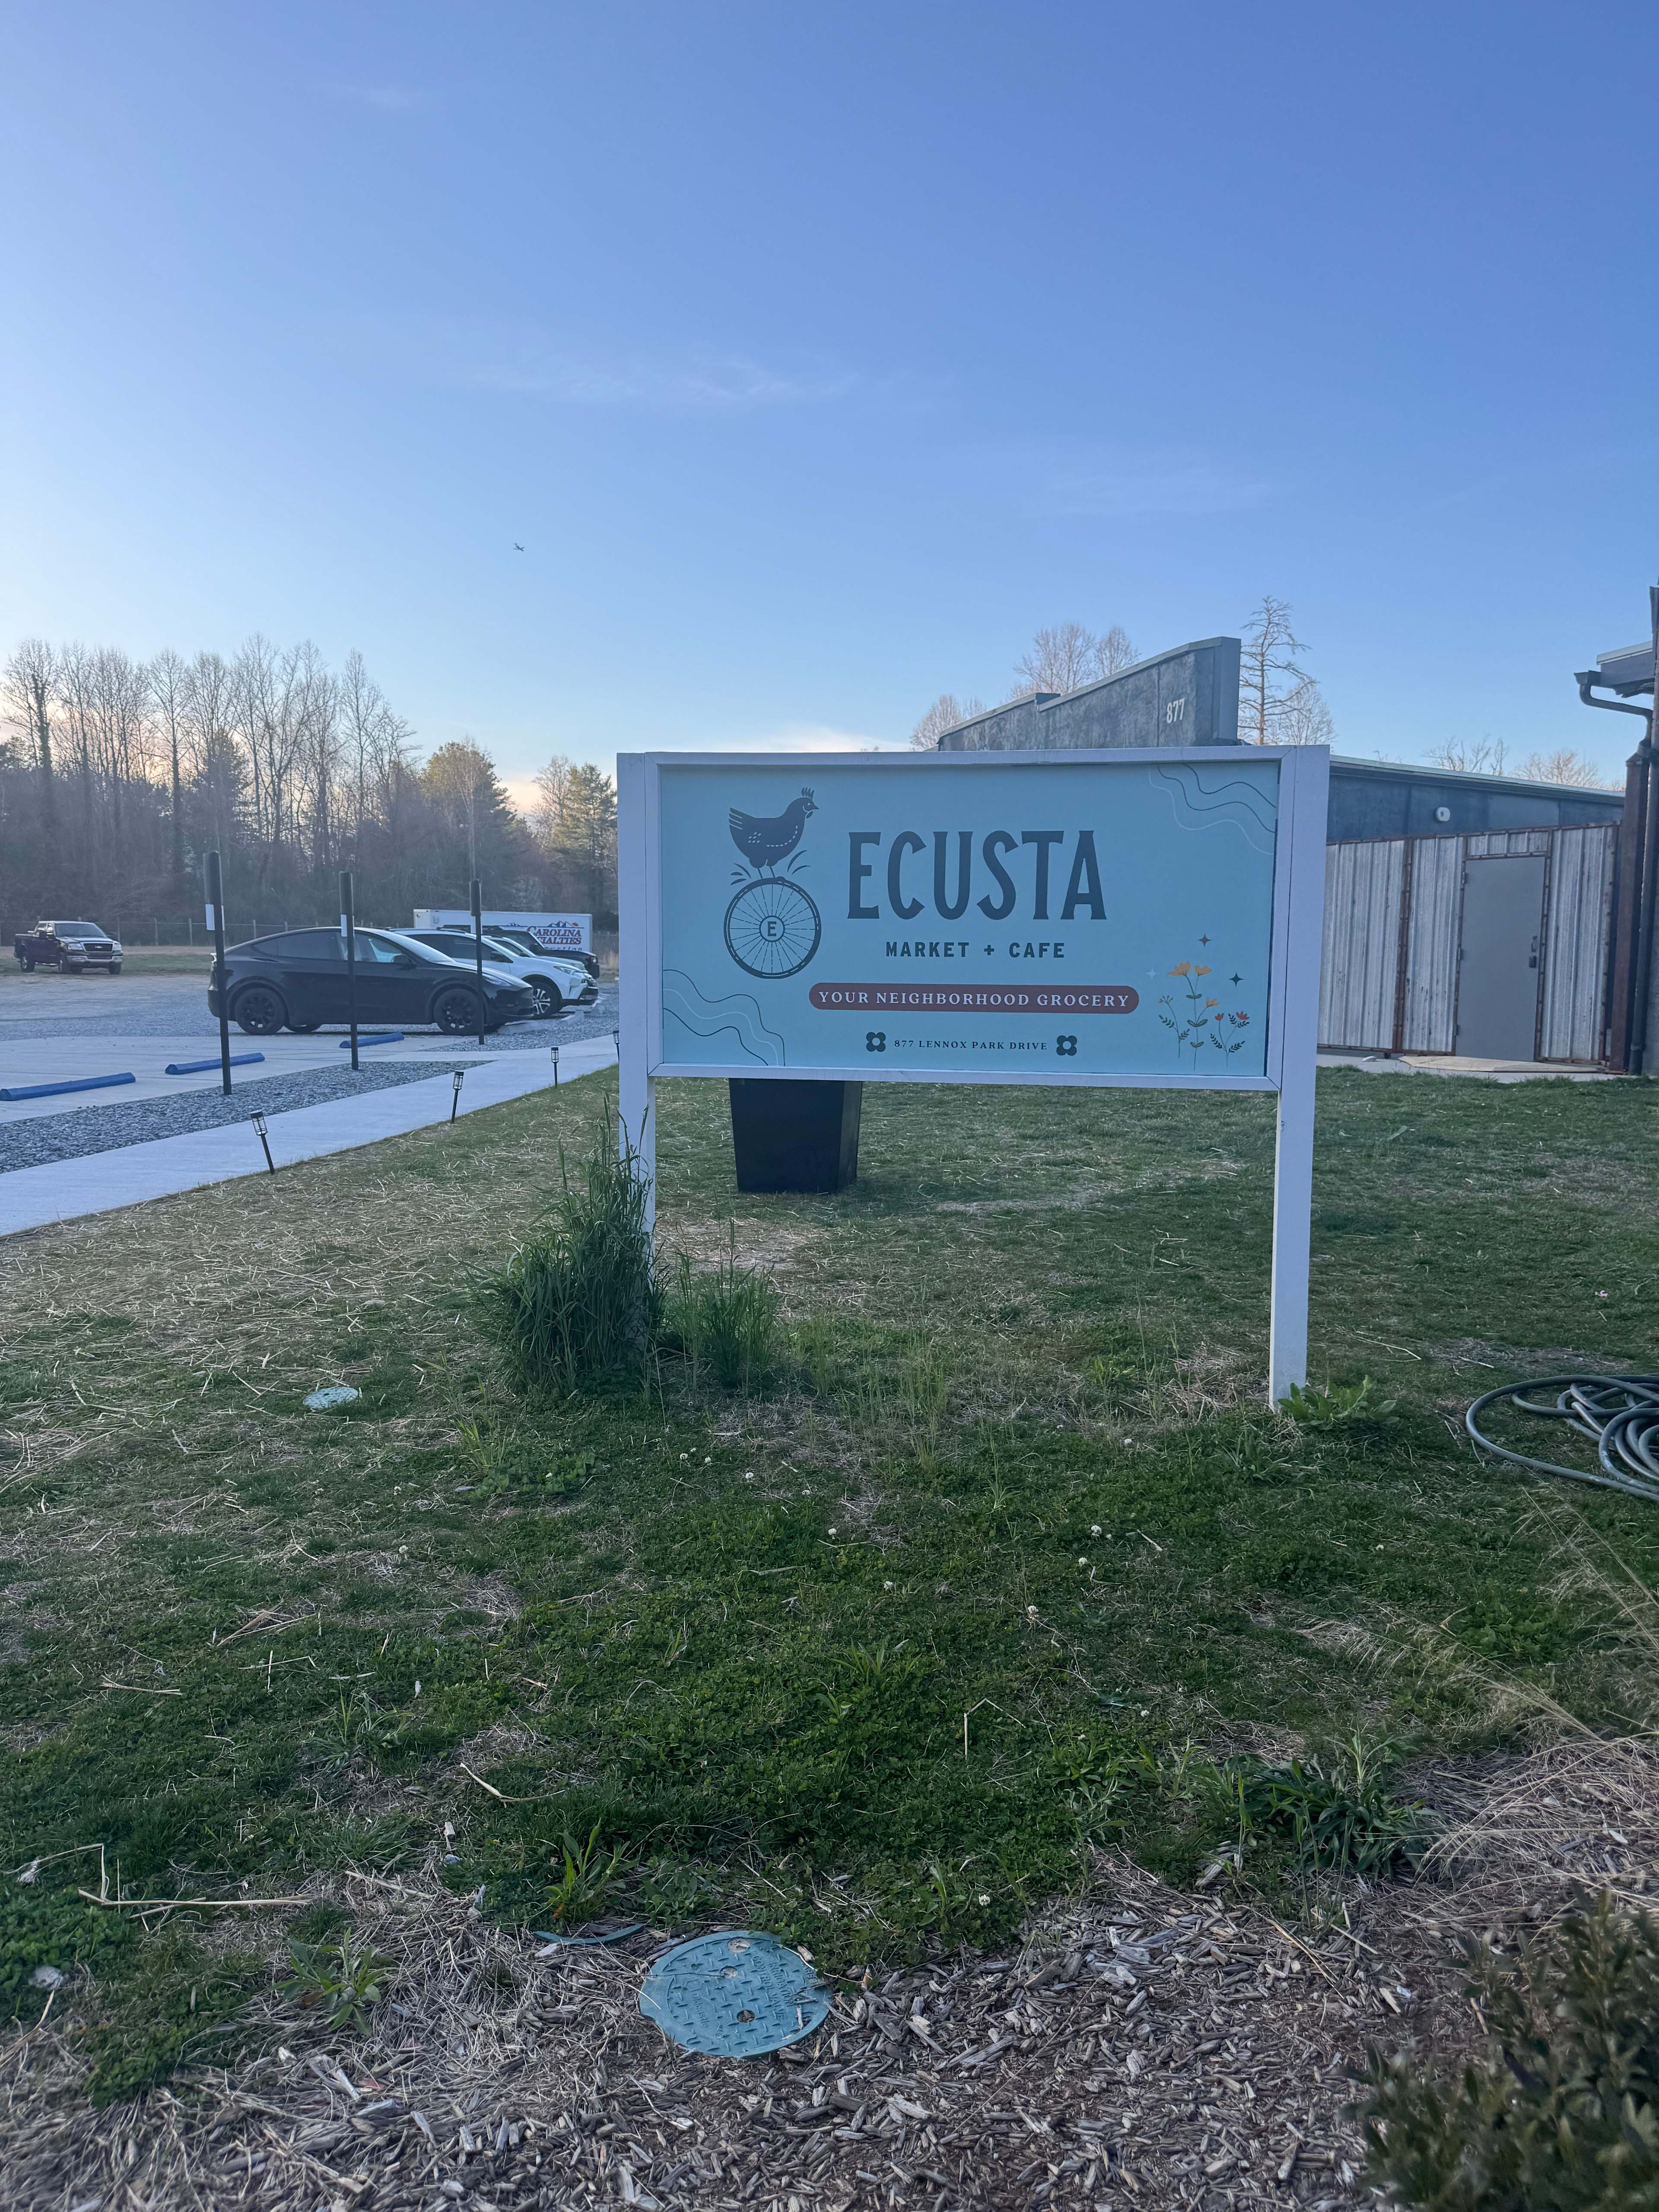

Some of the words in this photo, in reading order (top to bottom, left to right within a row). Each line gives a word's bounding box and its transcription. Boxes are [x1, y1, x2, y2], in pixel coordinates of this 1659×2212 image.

[1166, 698, 1185, 724] 877
[847, 830, 1107, 920] ECUSTA
[527, 926, 582, 937] CAROLINA
[767, 921, 777, 937] E
[886, 941, 969, 957] MARKET
[984, 945, 995, 956] +
[1009, 942, 1065, 958] CAFE
[819, 992, 868, 1004] YOUR
[876, 992, 1029, 1005] NEIGHBORHOOD
[1037, 995, 1129, 1007] GROCERY
[919, 1040, 967, 1049] LENNOX
[972, 1041, 1004, 1049] PARK
[753, 1956, 775, 1990] CONTROL
[769, 1993, 787, 2021] VALVE
